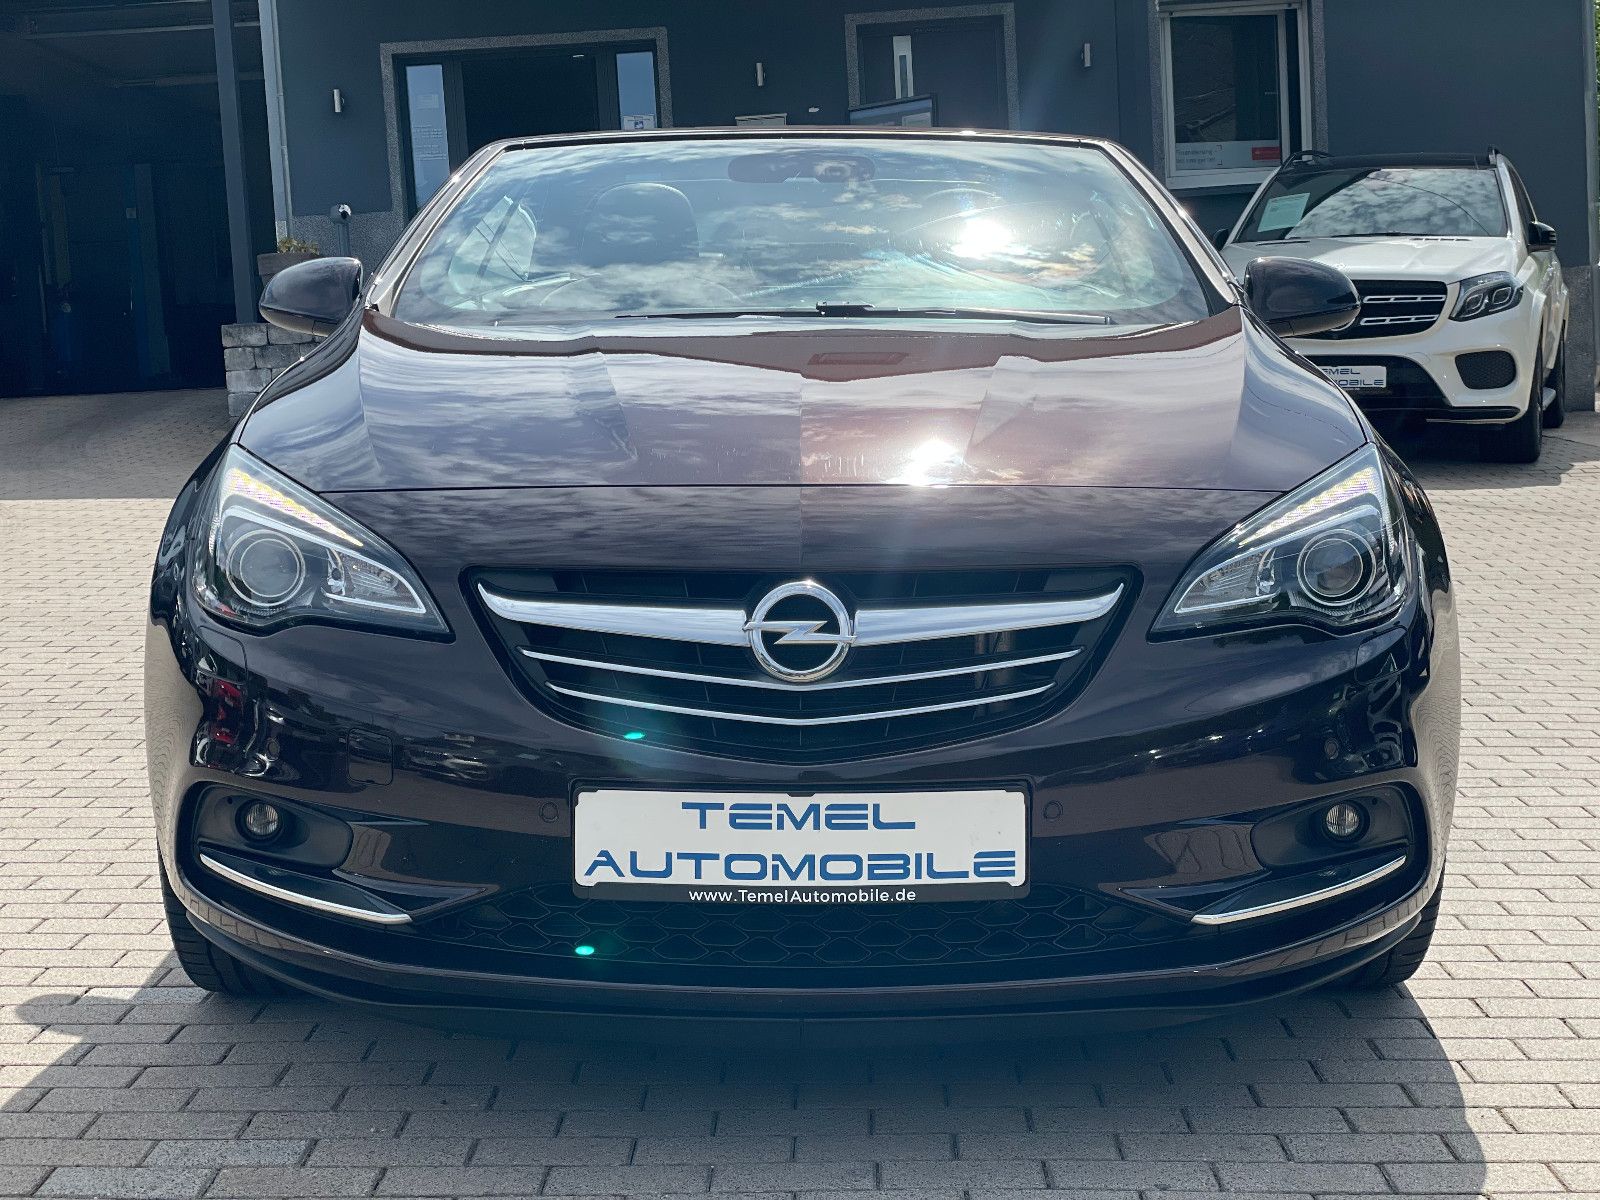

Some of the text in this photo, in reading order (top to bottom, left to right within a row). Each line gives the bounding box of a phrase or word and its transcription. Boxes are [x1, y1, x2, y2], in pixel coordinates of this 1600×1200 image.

[681, 801, 916, 831] TEMEL
[584, 849, 1016, 881] AUTOMOBILE
[688, 888, 917, 903] www.TemelAutomobile.de
